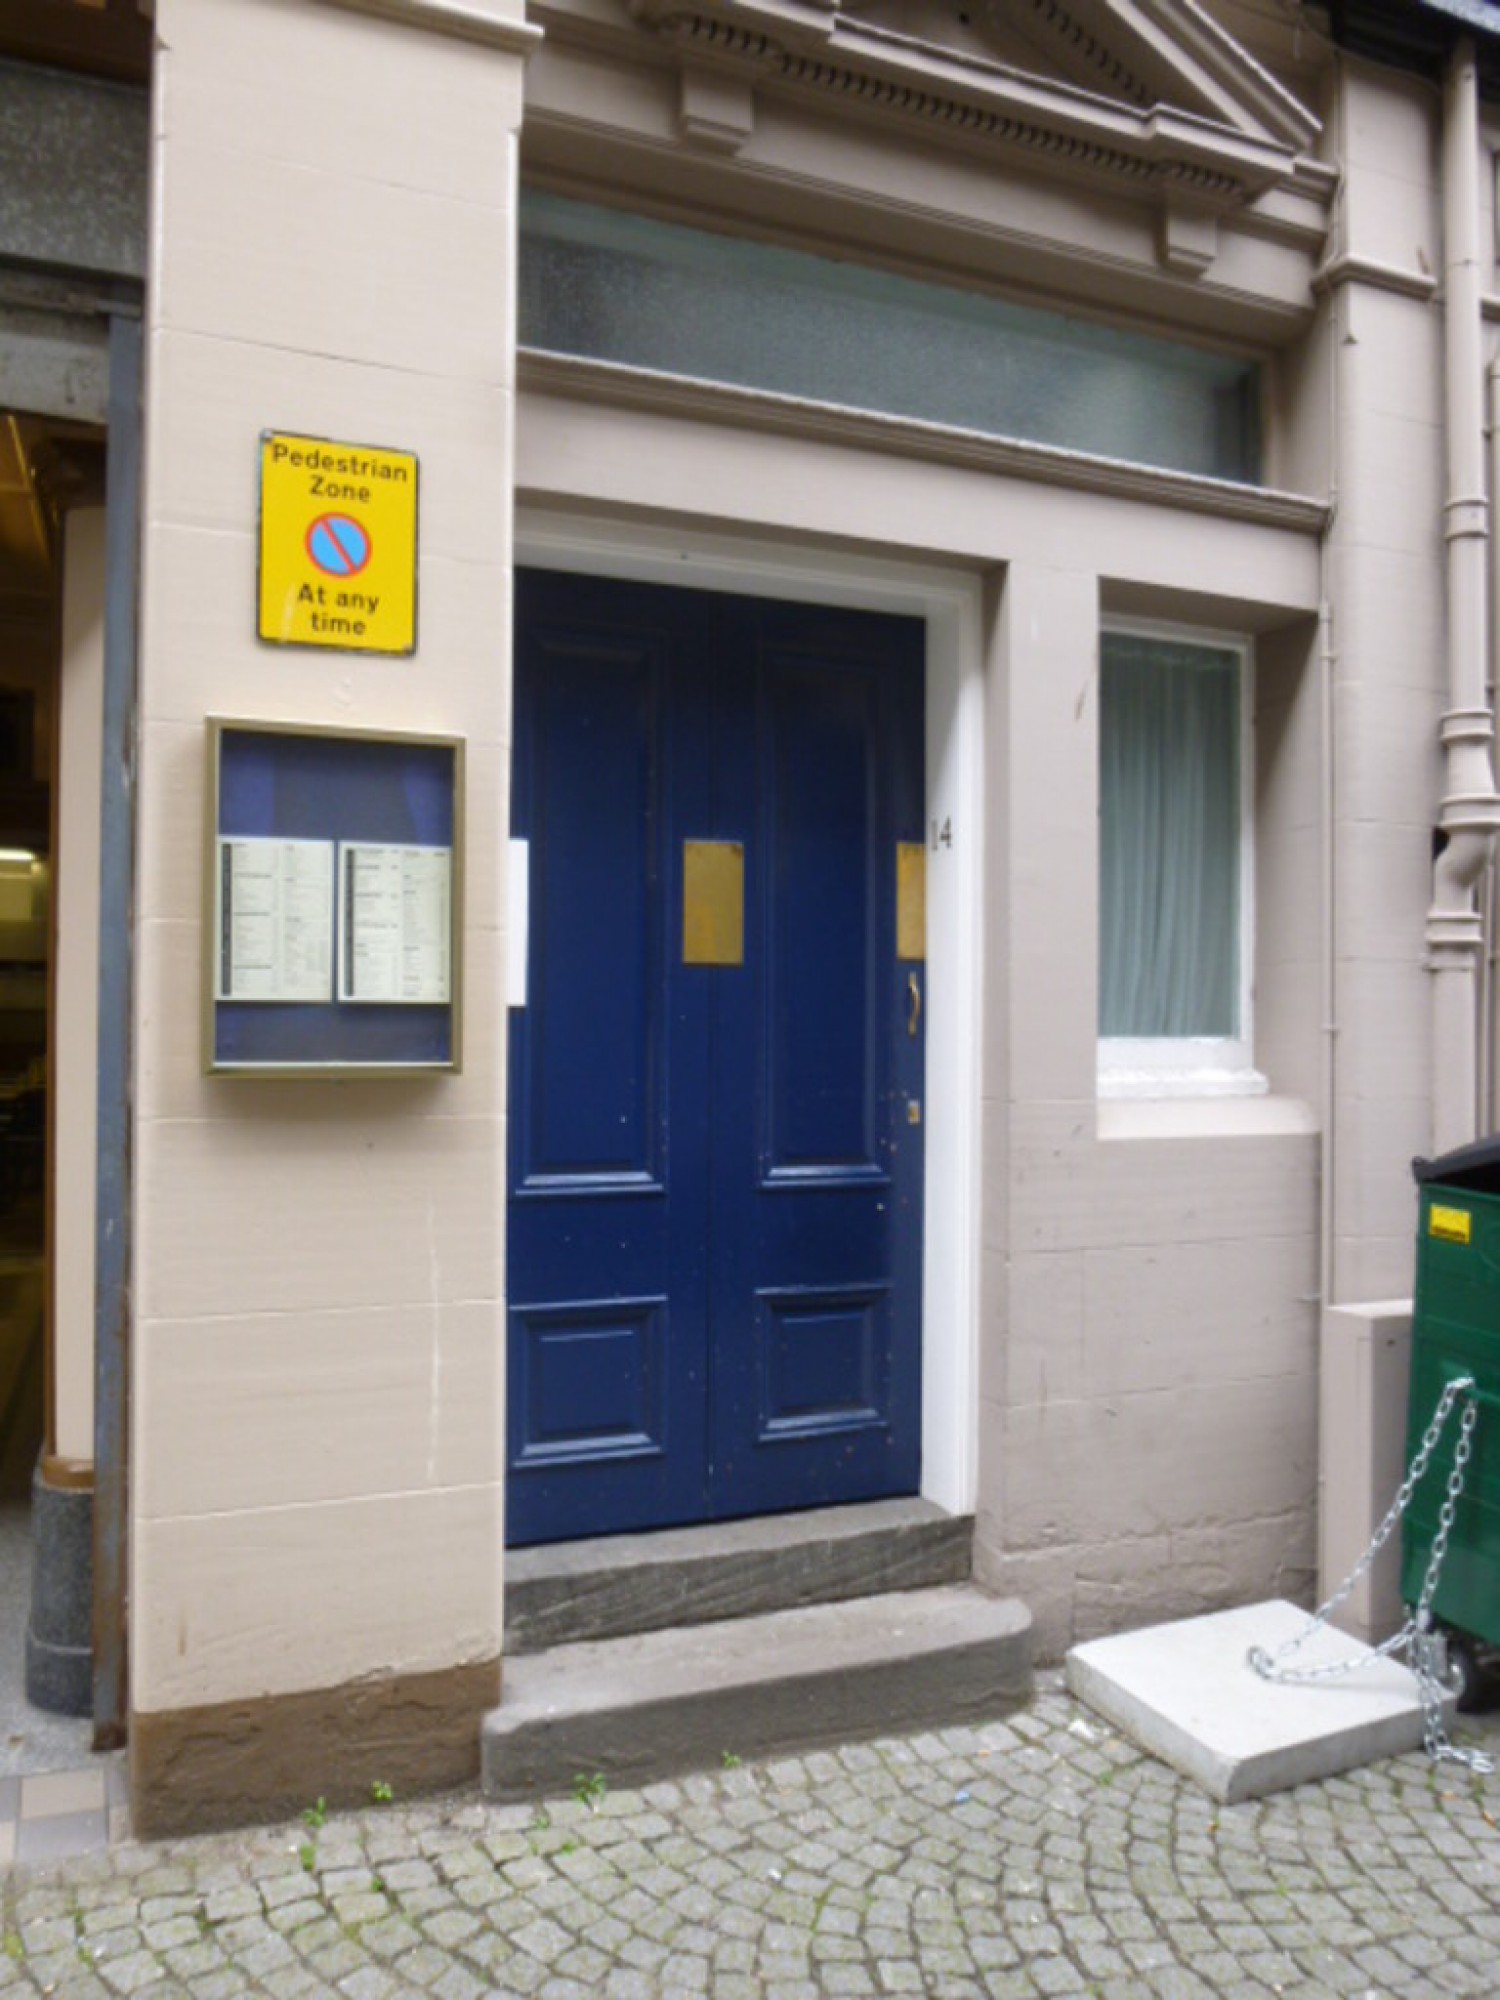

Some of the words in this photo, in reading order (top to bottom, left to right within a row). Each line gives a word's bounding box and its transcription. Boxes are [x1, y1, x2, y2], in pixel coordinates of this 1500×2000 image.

[272, 443, 408, 482] Pedestrian
[309, 474, 370, 502] Zone
[298, 583, 326, 606] At
[336, 590, 379, 614] any
[311, 611, 366, 635] time
[931, 815, 952, 851] 14
